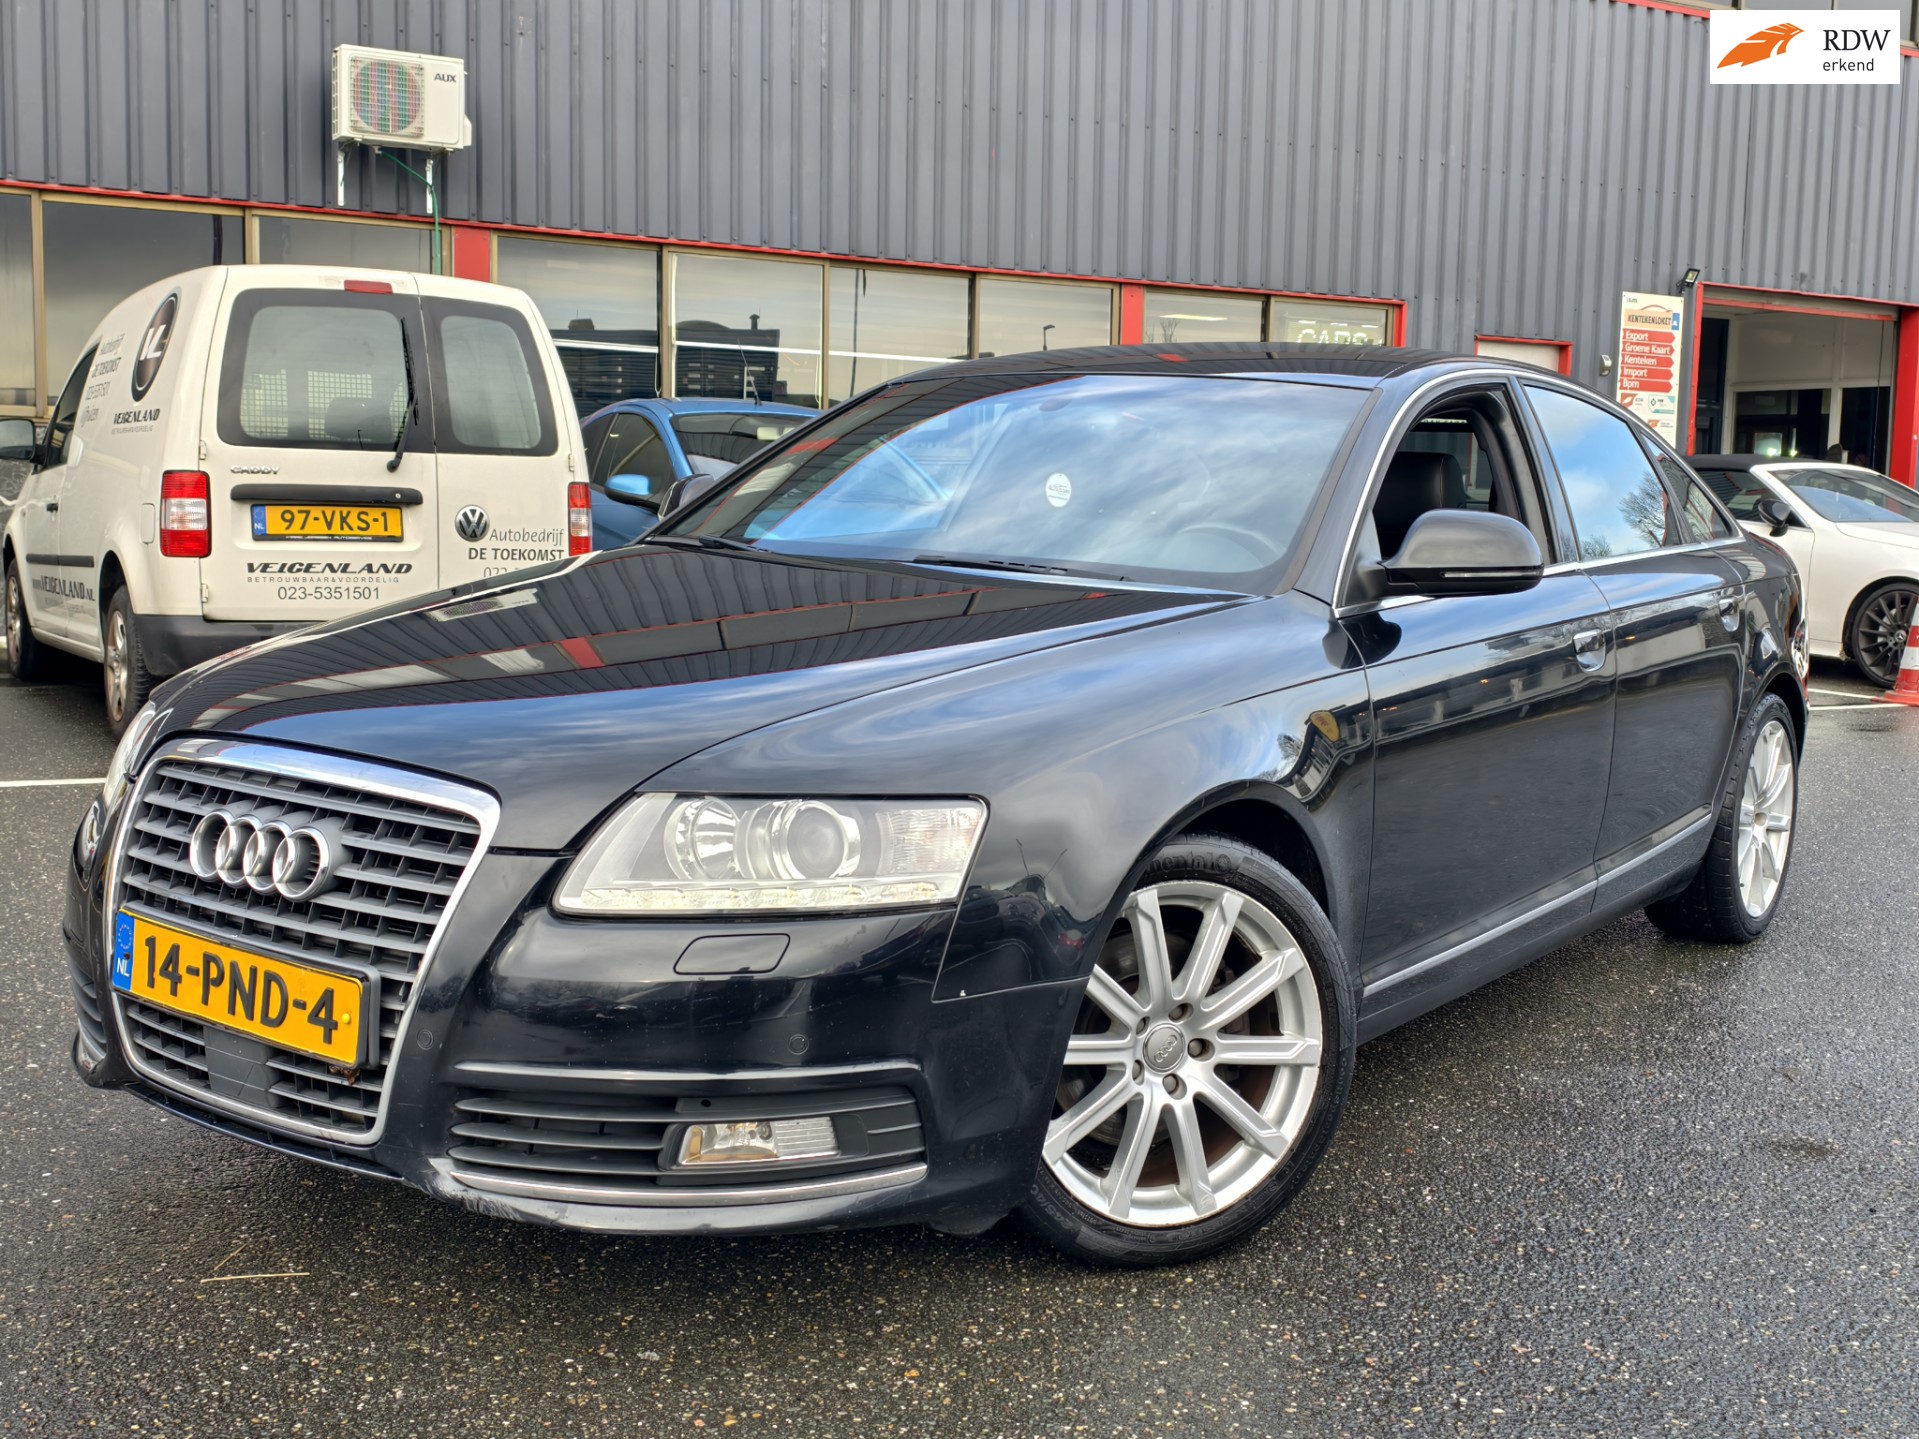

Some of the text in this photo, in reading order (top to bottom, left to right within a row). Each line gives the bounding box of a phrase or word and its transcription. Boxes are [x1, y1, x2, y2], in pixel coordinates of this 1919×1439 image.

[434, 73, 456, 83] AUX
[1628, 314, 1672, 326] KENTEKENLOKET
[1625, 330, 1649, 341] Export
[1625, 343, 1671, 355] Groene Kaart
[1624, 354, 1657, 366] Kenteken
[1624, 368, 1648, 379] Import
[1622, 379, 1640, 389] Bpm
[230, 465, 280, 475] CADDY
[254, 522, 265, 530] NL
[280, 509, 389, 532] 97-VKS-1
[489, 528, 565, 546] Autobedrijf
[468, 547, 565, 561] DE TOEKOMST
[247, 562, 413, 574] VEIGENLAND
[277, 586, 380, 600] 023-5351501
[116, 957, 130, 977] NL
[144, 935, 338, 1045] 14-PND-4
